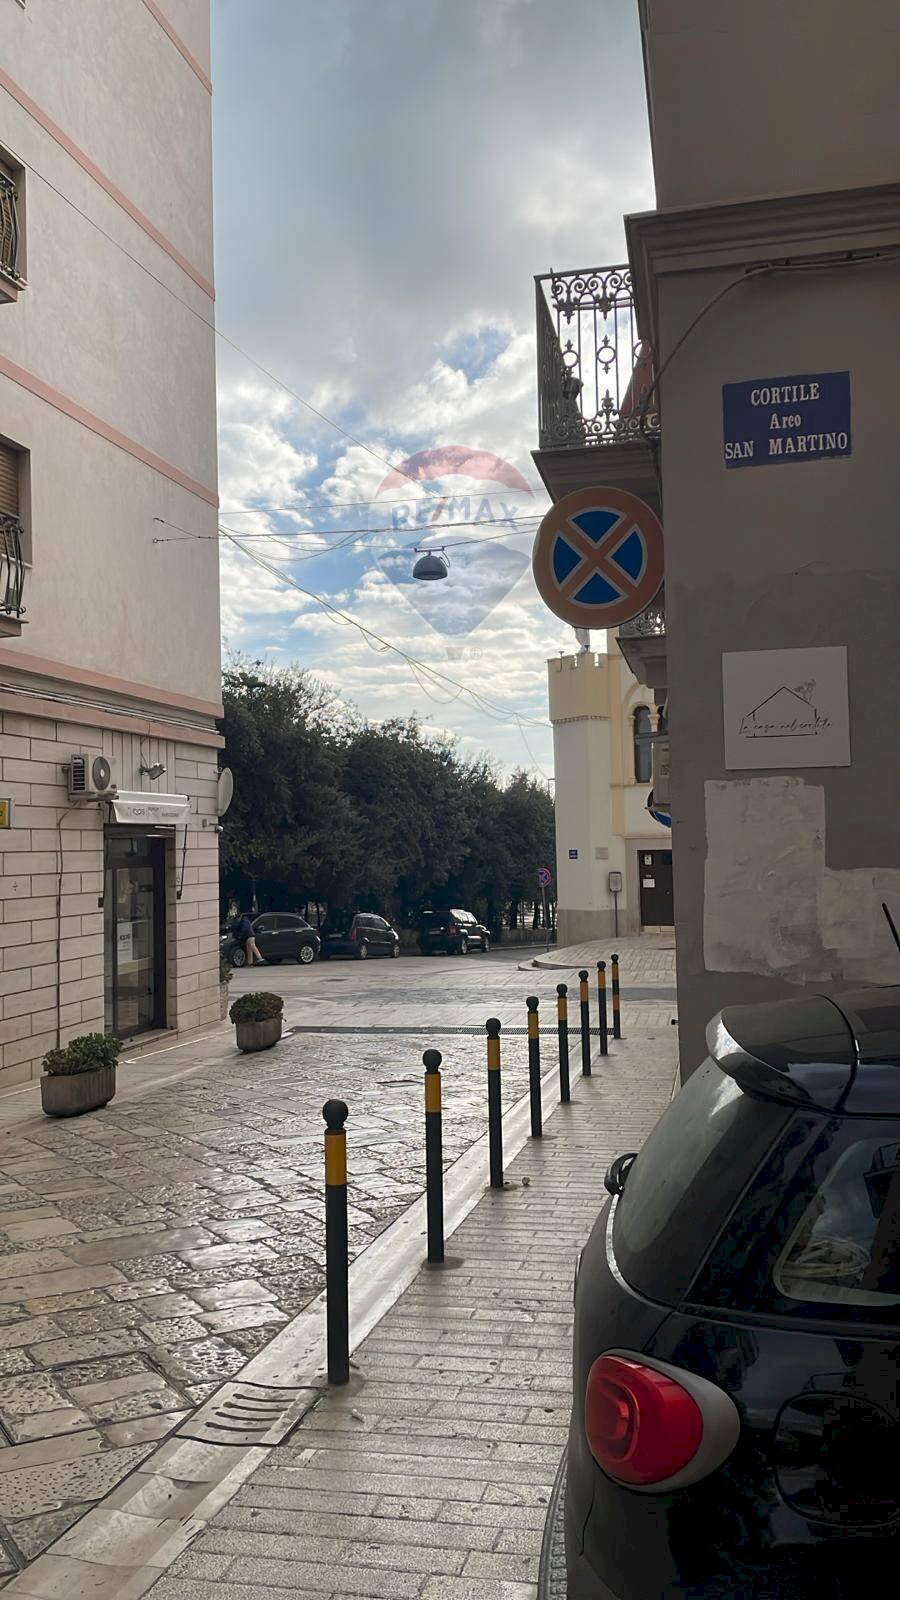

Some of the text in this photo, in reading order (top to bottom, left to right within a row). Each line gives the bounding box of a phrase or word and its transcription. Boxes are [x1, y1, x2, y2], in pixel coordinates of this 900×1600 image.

[751, 383, 820, 406] CORTILE
[770, 413, 801, 429] Arco
[725, 432, 848, 459] SAN MARTINO
